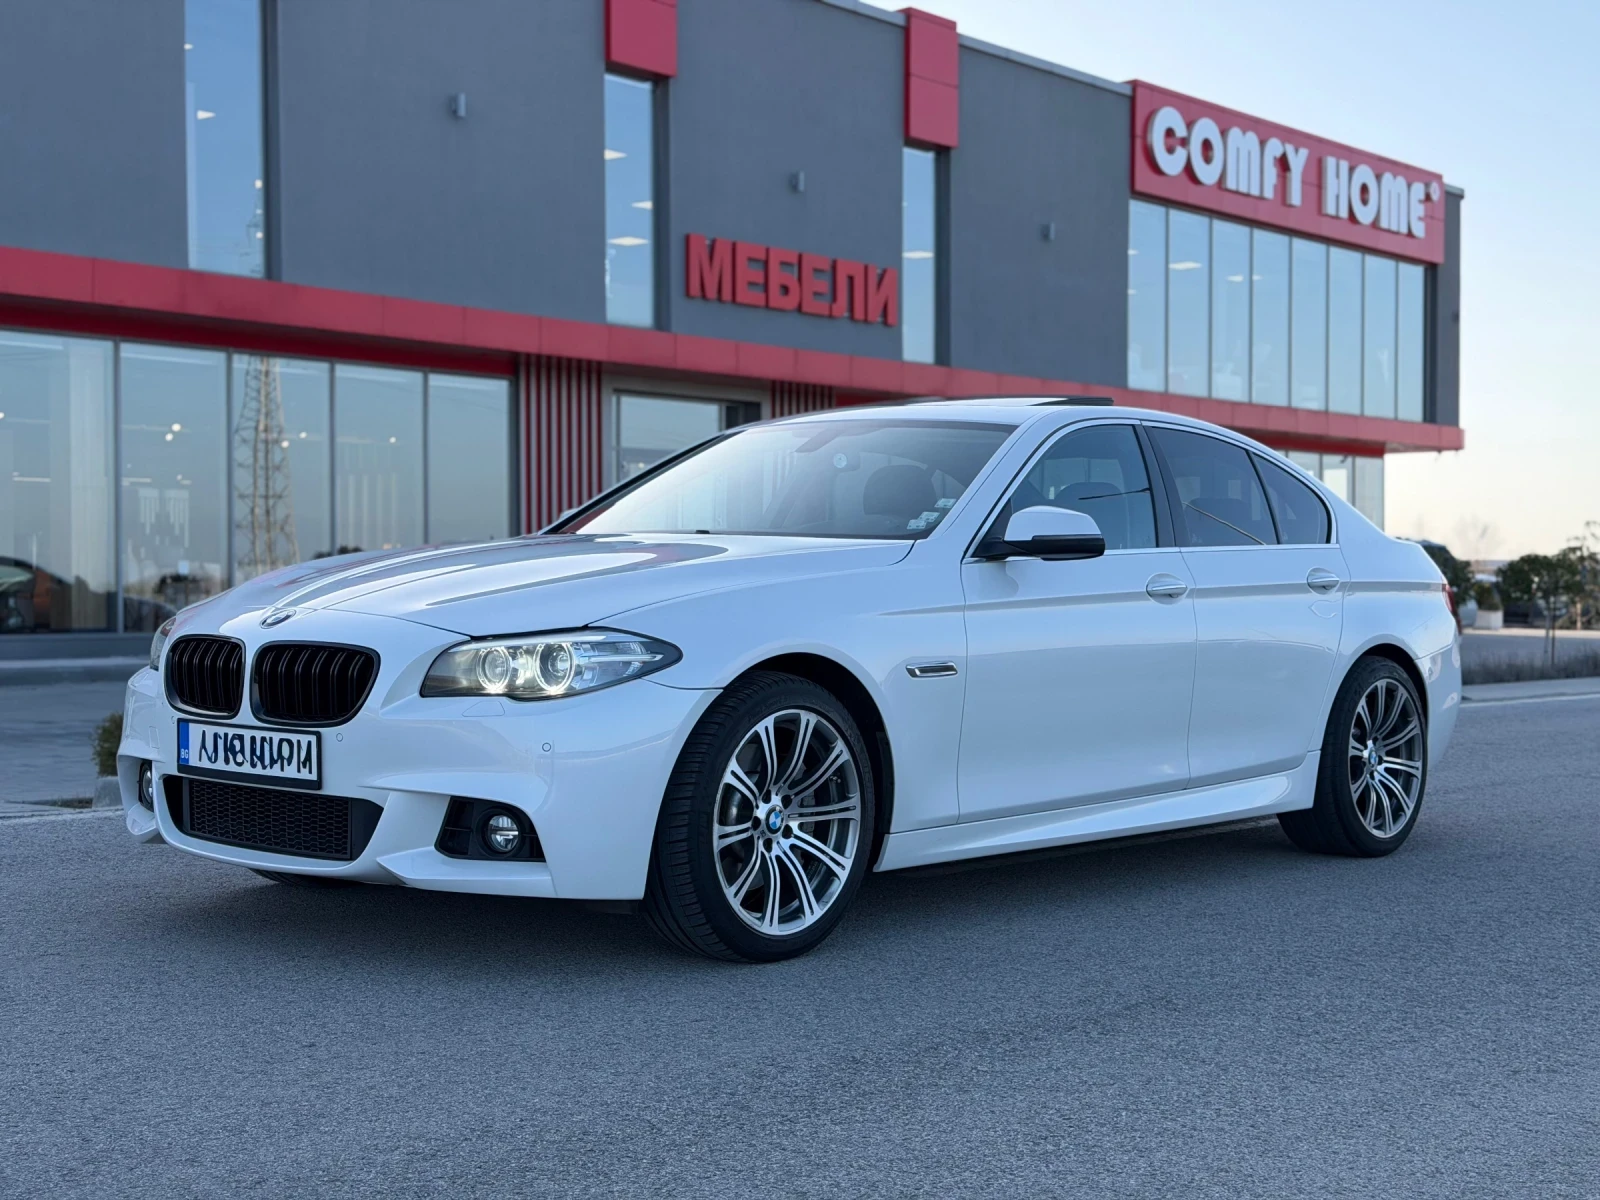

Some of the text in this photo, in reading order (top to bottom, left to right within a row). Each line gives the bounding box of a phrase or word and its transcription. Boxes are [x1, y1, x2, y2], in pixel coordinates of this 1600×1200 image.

[1150, 106, 1309, 207] COMFY
[685, 232, 899, 327] МЕБЕЛИ
[180, 748, 189, 759] BG
